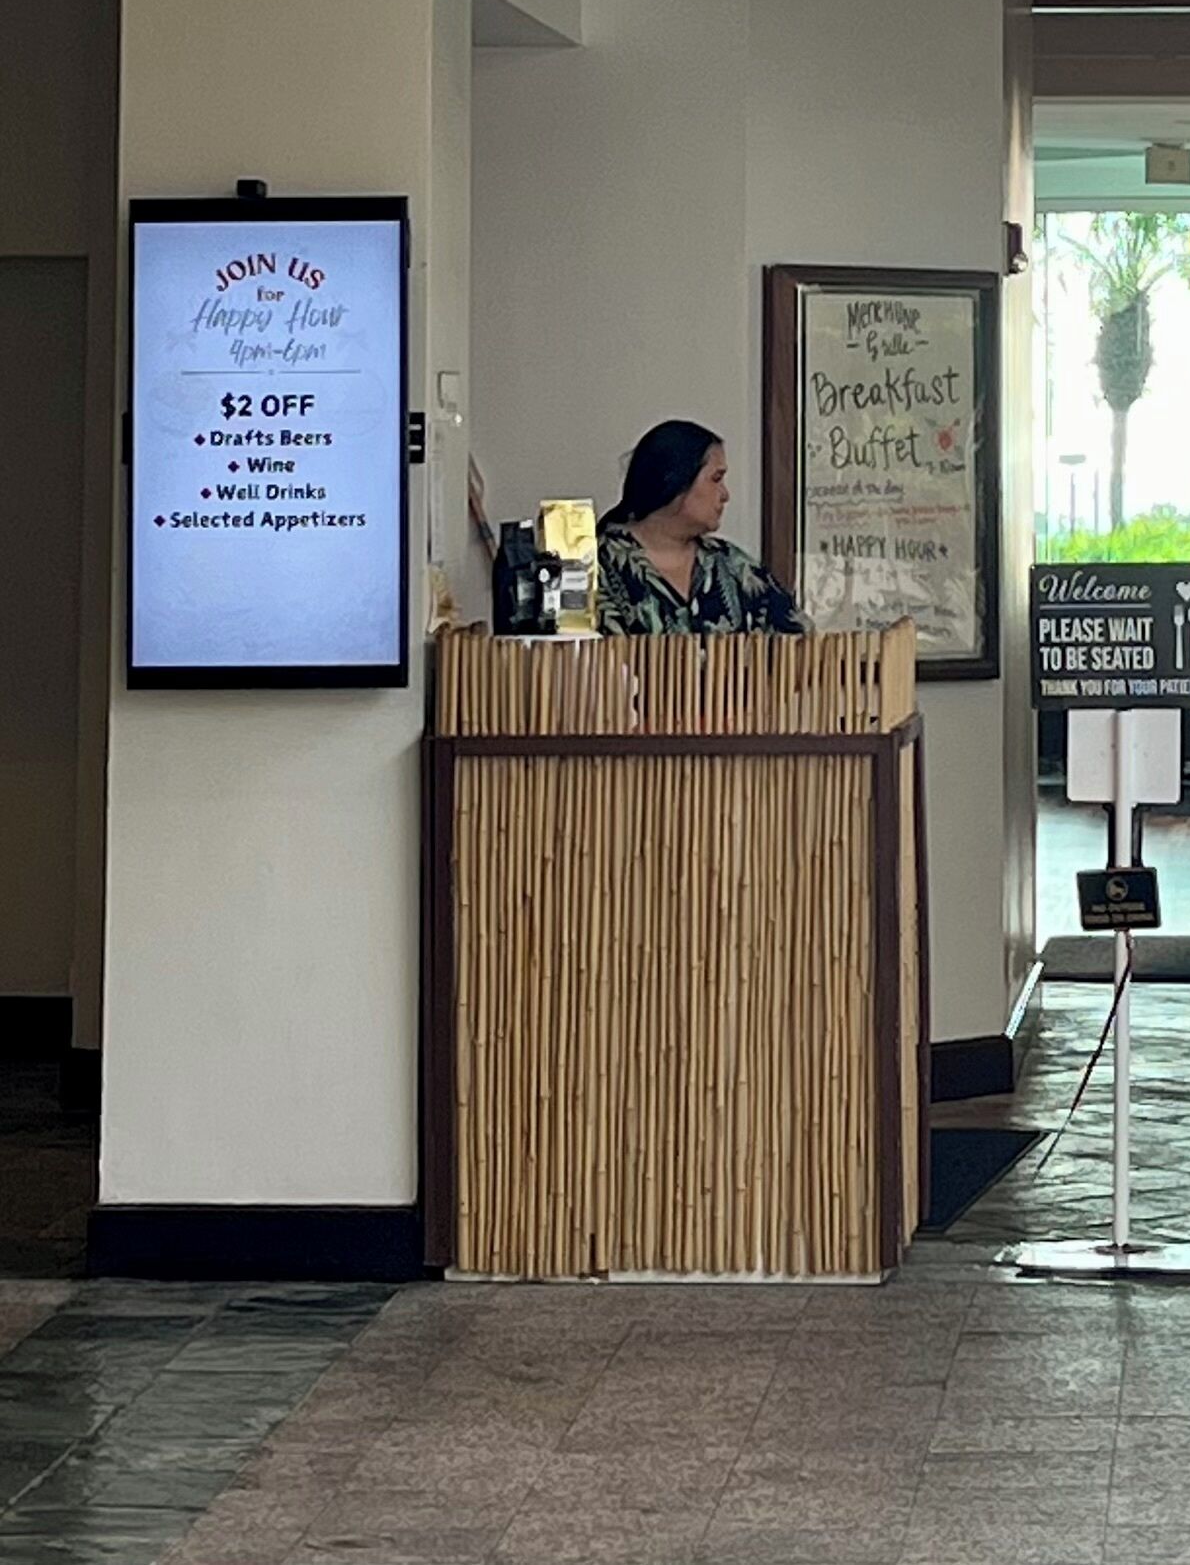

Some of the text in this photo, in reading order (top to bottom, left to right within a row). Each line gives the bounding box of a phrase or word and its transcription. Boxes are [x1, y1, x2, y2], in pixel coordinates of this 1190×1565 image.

[216, 253, 326, 292] JOIN US
[257, 286, 285, 302] for
[191, 297, 349, 335] Happy Hour
[811, 365, 960, 417] Breakfast
[221, 392, 315, 420] $2 OFF
[210, 429, 333, 446] Drafts Beers
[829, 425, 921, 471] Buffet
[247, 457, 296, 473] Wine
[216, 484, 327, 500] Well Drinks
[169, 510, 366, 532] Selected Appetizers
[833, 535, 937, 562] HAPPY HOUR
[1039, 570, 1152, 602] Welcome
[1039, 617, 1153, 643] PLEASE WAIT
[1040, 646, 1154, 671] TO BE SEATED
[1040, 679, 1078, 696] THANK
[1080, 679, 1102, 696] YOU
[1104, 679, 1127, 696] FOR
[1129, 679, 1158, 696] YOUR
